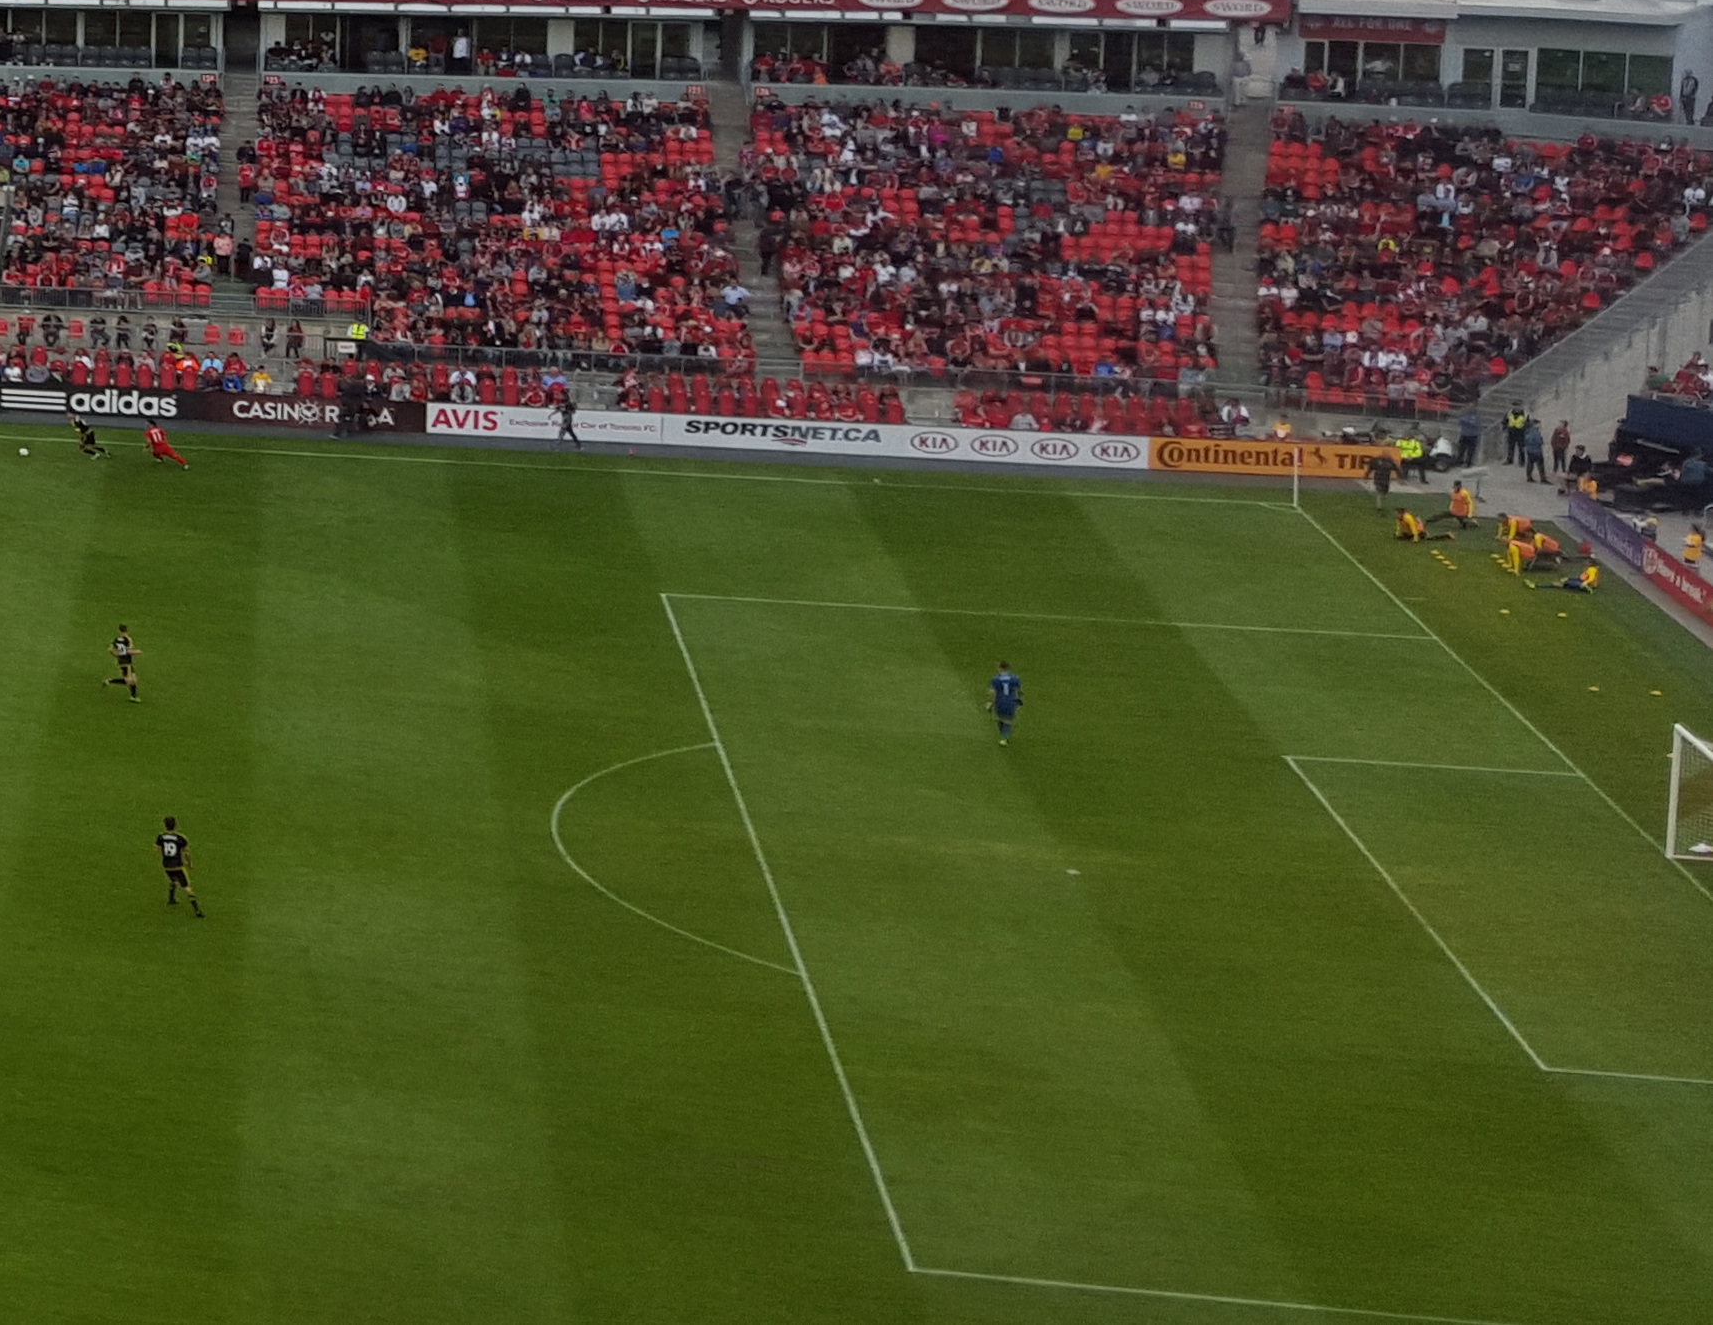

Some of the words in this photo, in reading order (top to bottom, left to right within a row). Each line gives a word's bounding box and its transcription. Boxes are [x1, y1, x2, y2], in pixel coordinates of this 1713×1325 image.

[1211, 1, 1265, 13] SWORD
[71, 391, 177, 418] adidas
[325, 405, 395, 426] RA
[431, 408, 499, 431] AVIS
[685, 419, 882, 444] SPORTSNET.CA
[918, 436, 949, 451] KIA
[979, 439, 1011, 453] KIA
[1039, 442, 1071, 456] KIA
[1099, 444, 1132, 459] KIA
[1156, 440, 1303, 469] Continental
[163, 841, 178, 857] 19
